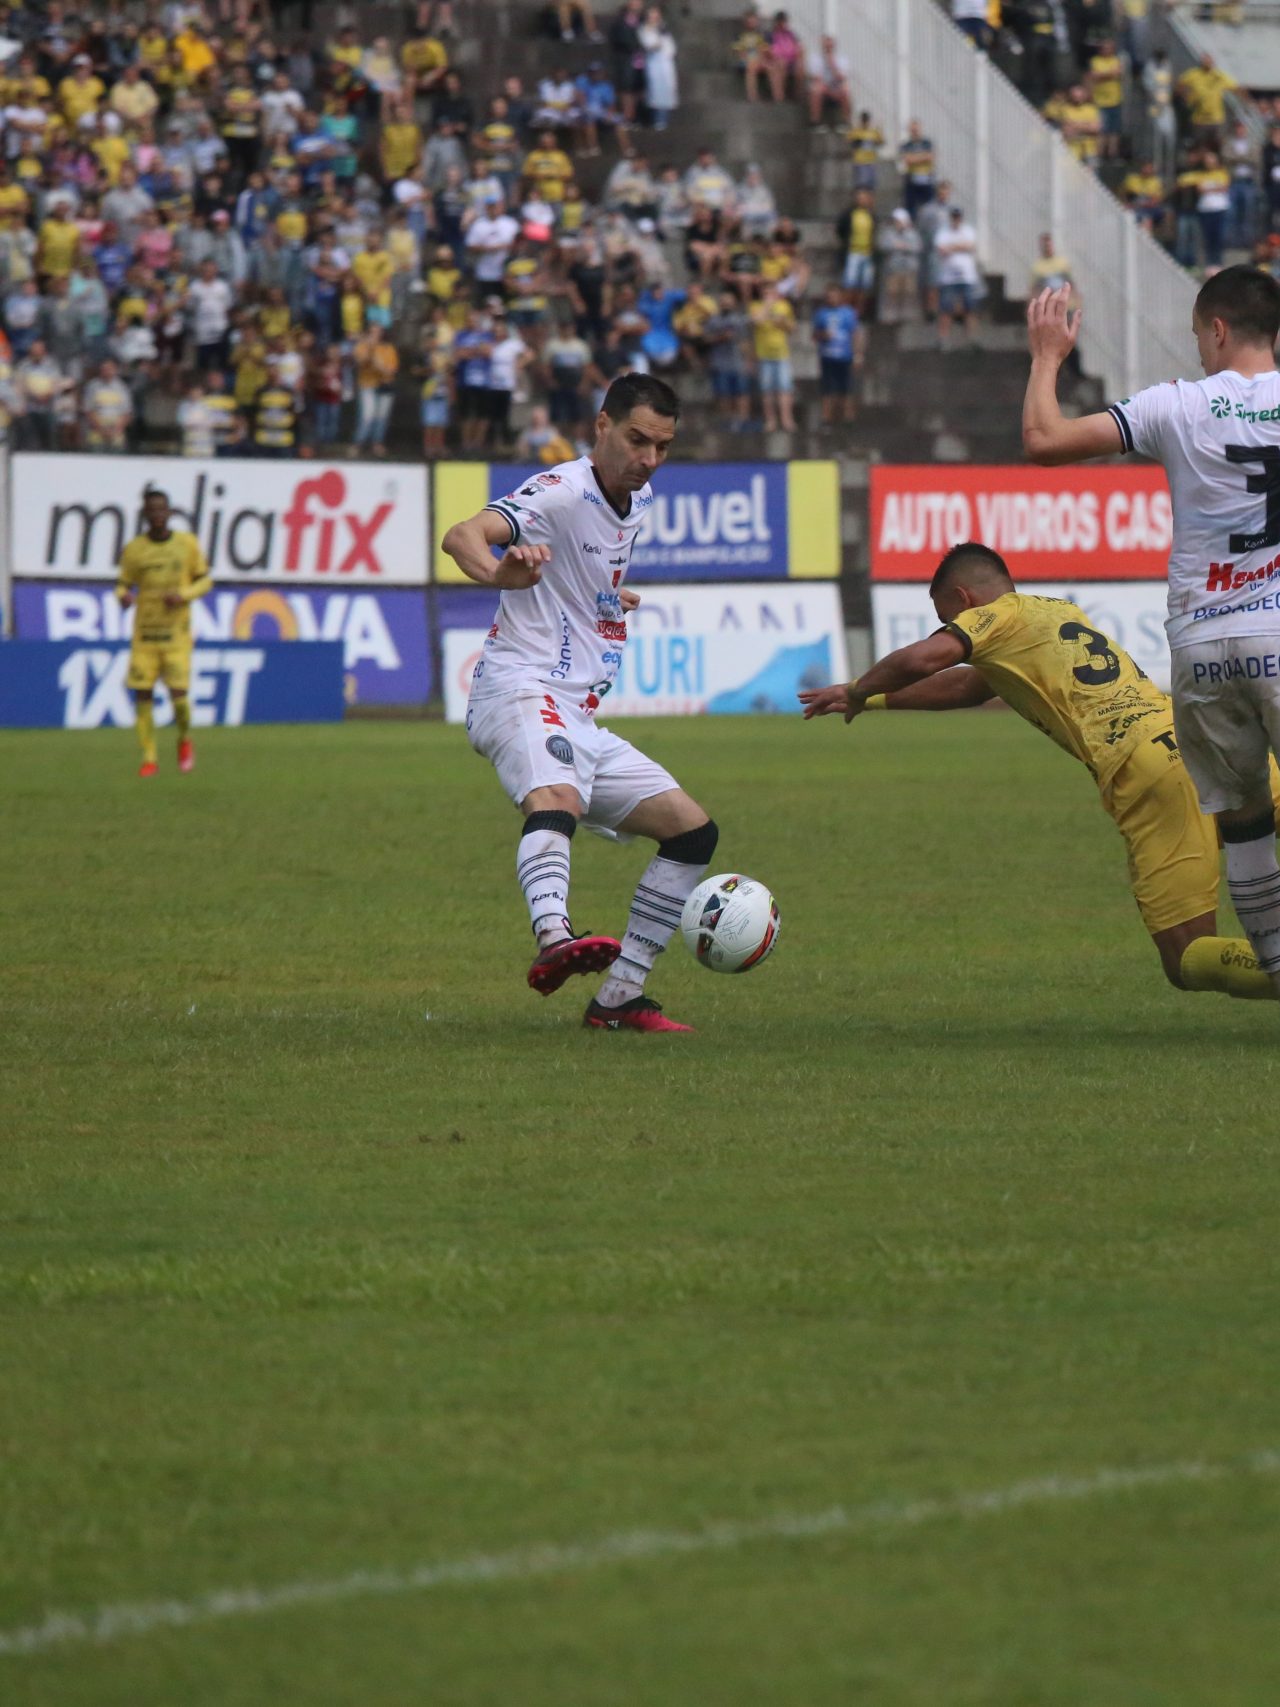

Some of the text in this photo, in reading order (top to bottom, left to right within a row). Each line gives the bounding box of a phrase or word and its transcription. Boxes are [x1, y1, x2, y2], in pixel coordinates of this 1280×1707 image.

[879, 492, 971, 551] AUTO
[976, 492, 1099, 550] VIDROS
[57, 650, 266, 728] 1XET
